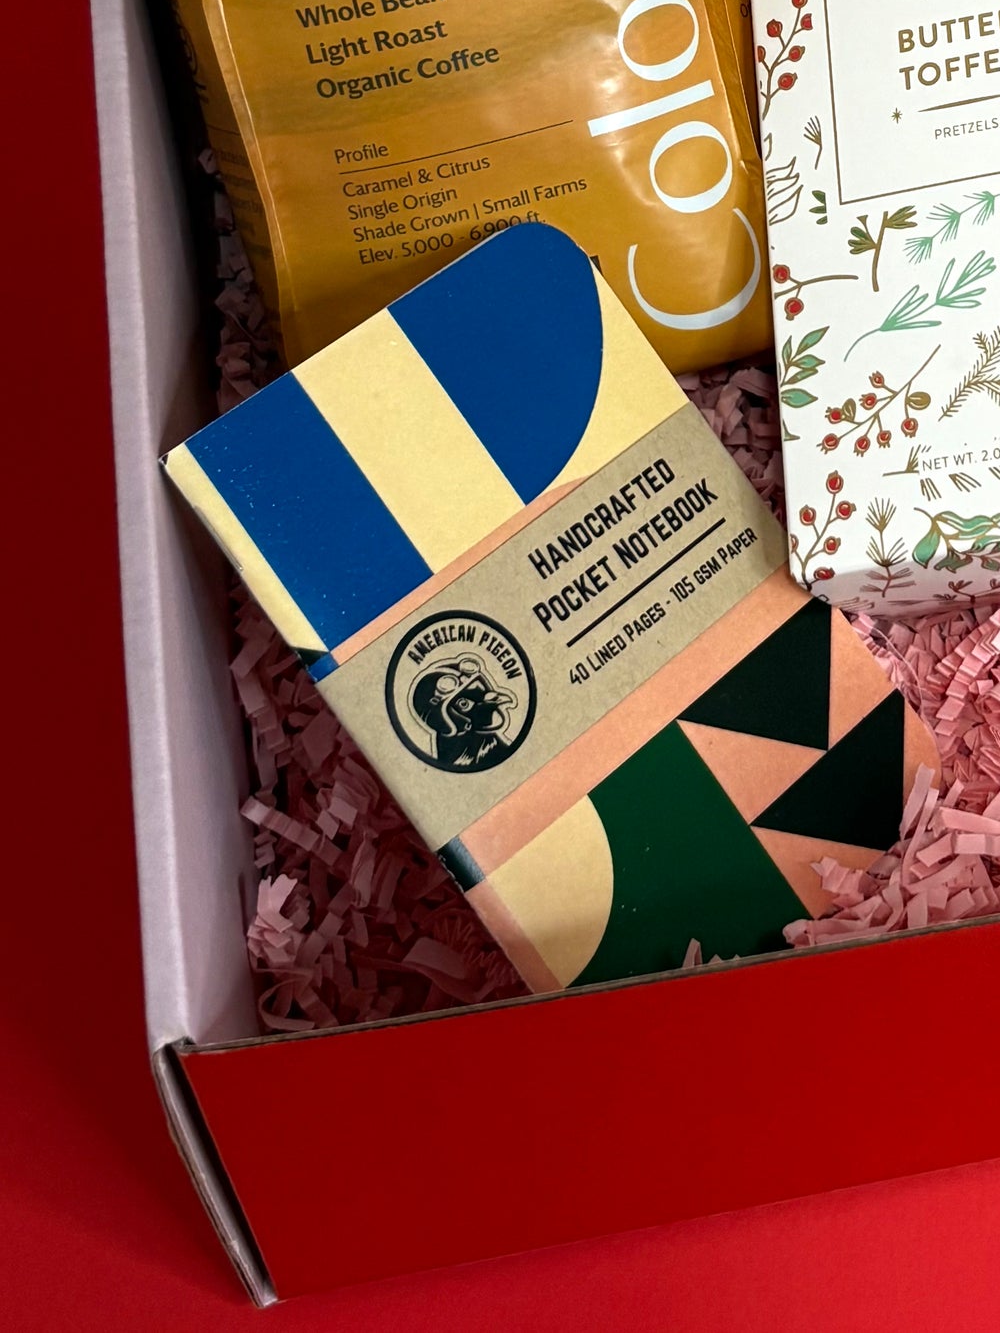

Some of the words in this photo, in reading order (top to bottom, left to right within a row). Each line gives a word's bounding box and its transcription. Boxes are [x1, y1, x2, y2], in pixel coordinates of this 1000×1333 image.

[296, 0, 376, 28] Whole
[306, 37, 371, 66] Light
[373, 20, 448, 51] Roast
[316, 66, 412, 99] Organic
[417, 47, 500, 79] Coffee
[934, 117, 999, 140] PRETZELS
[334, 143, 389, 164] Profile
[343, 172, 413, 197] Caramel
[418, 169, 433, 184] &
[436, 156, 491, 179] Citrus
[348, 199, 399, 221] Single
[403, 187, 458, 209] Origin
[353, 222, 406, 243] Shade
[410, 208, 470, 232] Grown
[482, 190, 531, 215] Small
[533, 177, 588, 201] Farms
[359, 242, 397, 265] Elev.
[402, 232, 454, 258] 5,000
[922, 456, 949, 471] NET
[953, 452, 978, 466] WT.
[981, 447, 1000, 462] 2.0
[527, 457, 676, 580] HANDCRAFTED
[532, 556, 618, 633] POCKET
[612, 477, 719, 569] NOTEBOOK
[569, 664, 590, 687] 40
[588, 634, 628, 671] LINED
[626, 602, 667, 644] PAGES
[669, 575, 695, 605] 105
[693, 557, 722, 586] GSM
[717, 526, 759, 565] PAPER
[407, 624, 476, 665] AMERICAN
[478, 631, 523, 680] PIGEON
